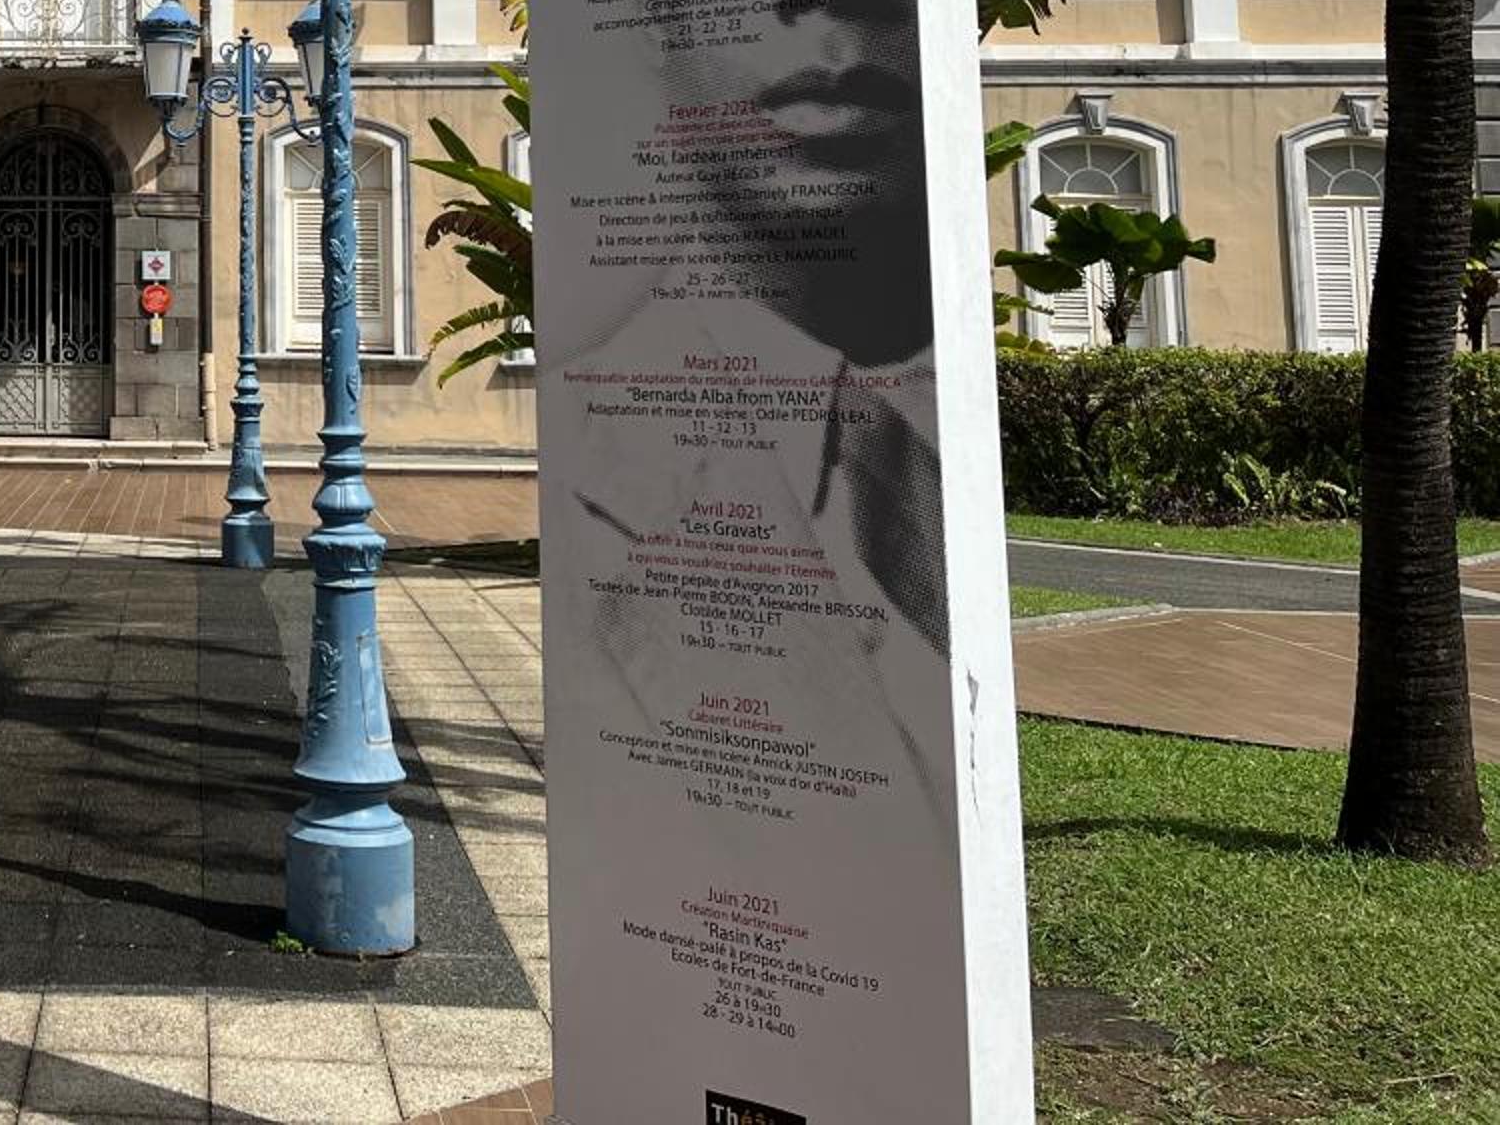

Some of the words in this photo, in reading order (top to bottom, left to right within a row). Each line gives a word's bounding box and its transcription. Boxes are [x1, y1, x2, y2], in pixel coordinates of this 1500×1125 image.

[684, 354, 721, 371] Mars
[724, 356, 758, 371] 2021
[626, 387, 696, 403] "Bernarda
[700, 389, 734, 404] Alba
[736, 390, 774, 405] from
[776, 390, 827, 406] YANA"
[586, 402, 648, 418] Adaptation
[665, 405, 694, 418] mise
[694, 409, 713, 418] en
[755, 408, 789, 421] Odile
[715, 421, 731, 434] 12
[691, 499, 723, 518] Avril
[727, 502, 763, 520] 2021
[679, 517, 710, 535] "Les
[713, 520, 777, 540] Gravats"
[760, 544, 788, 554] vous
[645, 566, 680, 582] Petite
[787, 580, 819, 596] 2017
[623, 580, 641, 595] de
[757, 594, 822, 613] Alexandre
[824, 601, 891, 623] BRISSON,
[729, 608, 783, 627] MOLLET
[700, 620, 713, 633] 15
[725, 623, 739, 636] 16
[749, 625, 765, 639] 17
[699, 691, 729, 710] Juin
[732, 696, 770, 717] 2021
[658, 719, 816, 758] "Sonmisiksonpawol"
[753, 752, 794, 771] Annick
[795, 759, 838, 778] JUSTIN
[839, 766, 890, 786] JOSEPH
[726, 781, 740, 795] 18
[756, 786, 771, 800] 19
[707, 885, 739, 908] Juin
[742, 893, 779, 916] 2021
[703, 920, 750, 944] "Rasin
[754, 931, 788, 954] Kas"
[622, 920, 657, 940] Mode
[739, 950, 785, 970] propos
[786, 958, 803, 974] de
[820, 966, 860, 987] Covid
[861, 975, 880, 992] 19
[712, 958, 729, 974] de
[730, 962, 825, 996] Fort-de-France
[715, 990, 731, 1006] 26
[702, 1002, 718, 1019] 28
[729, 1009, 745, 1025] 29
